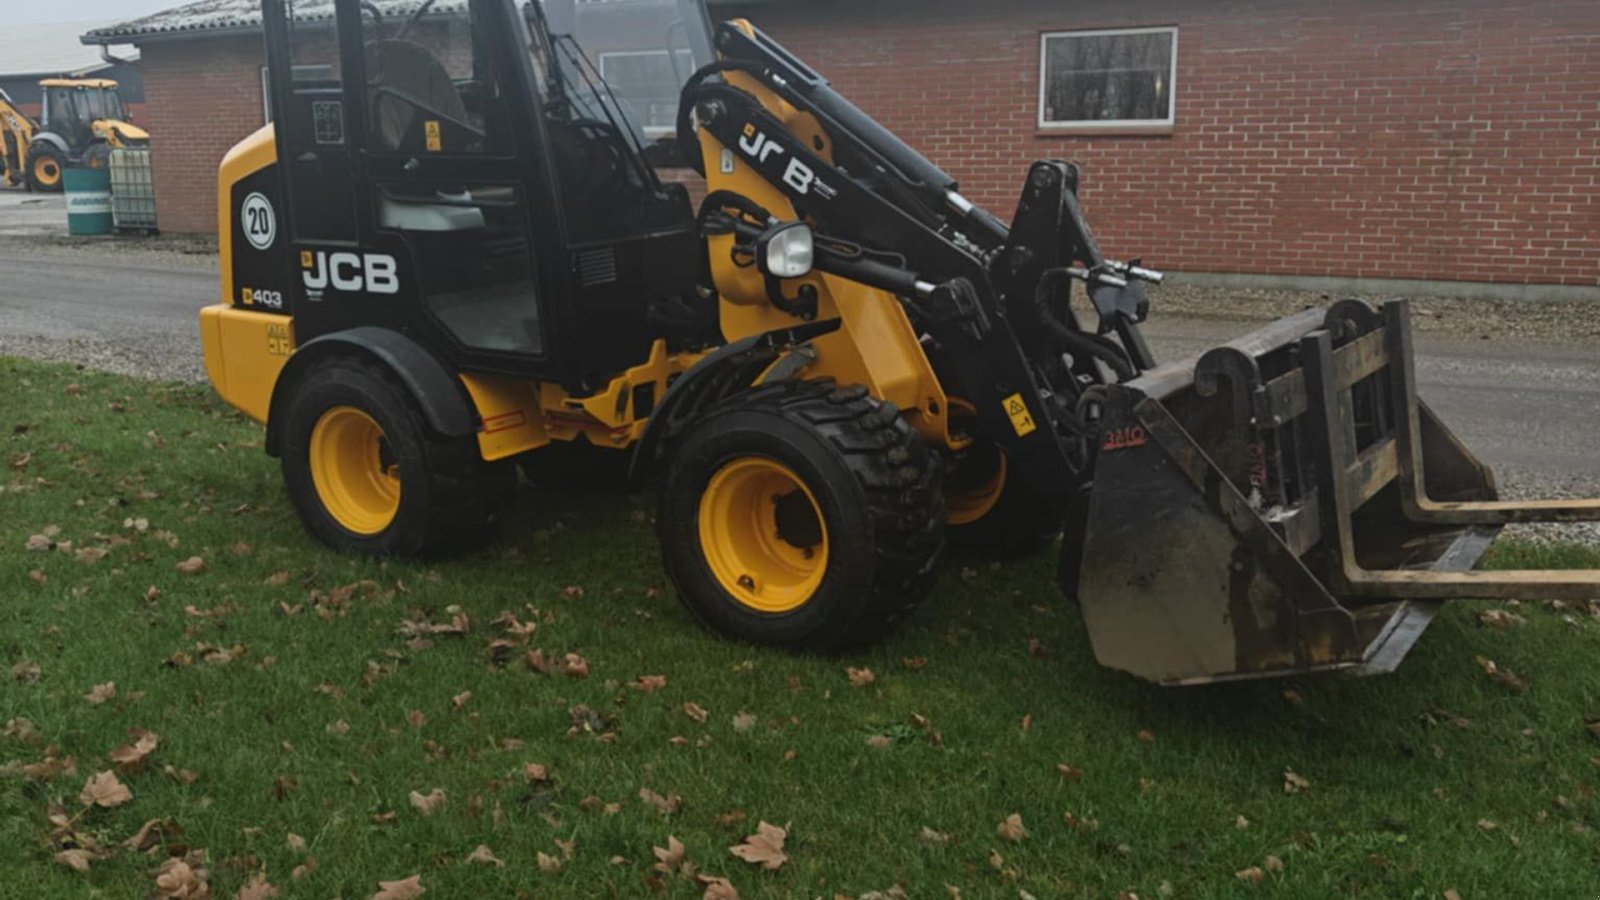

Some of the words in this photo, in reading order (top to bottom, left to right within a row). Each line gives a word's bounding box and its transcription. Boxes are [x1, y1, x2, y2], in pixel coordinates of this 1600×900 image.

[248, 206, 270, 236] 20
[301, 251, 399, 294] JCB
[253, 289, 282, 306] 403
